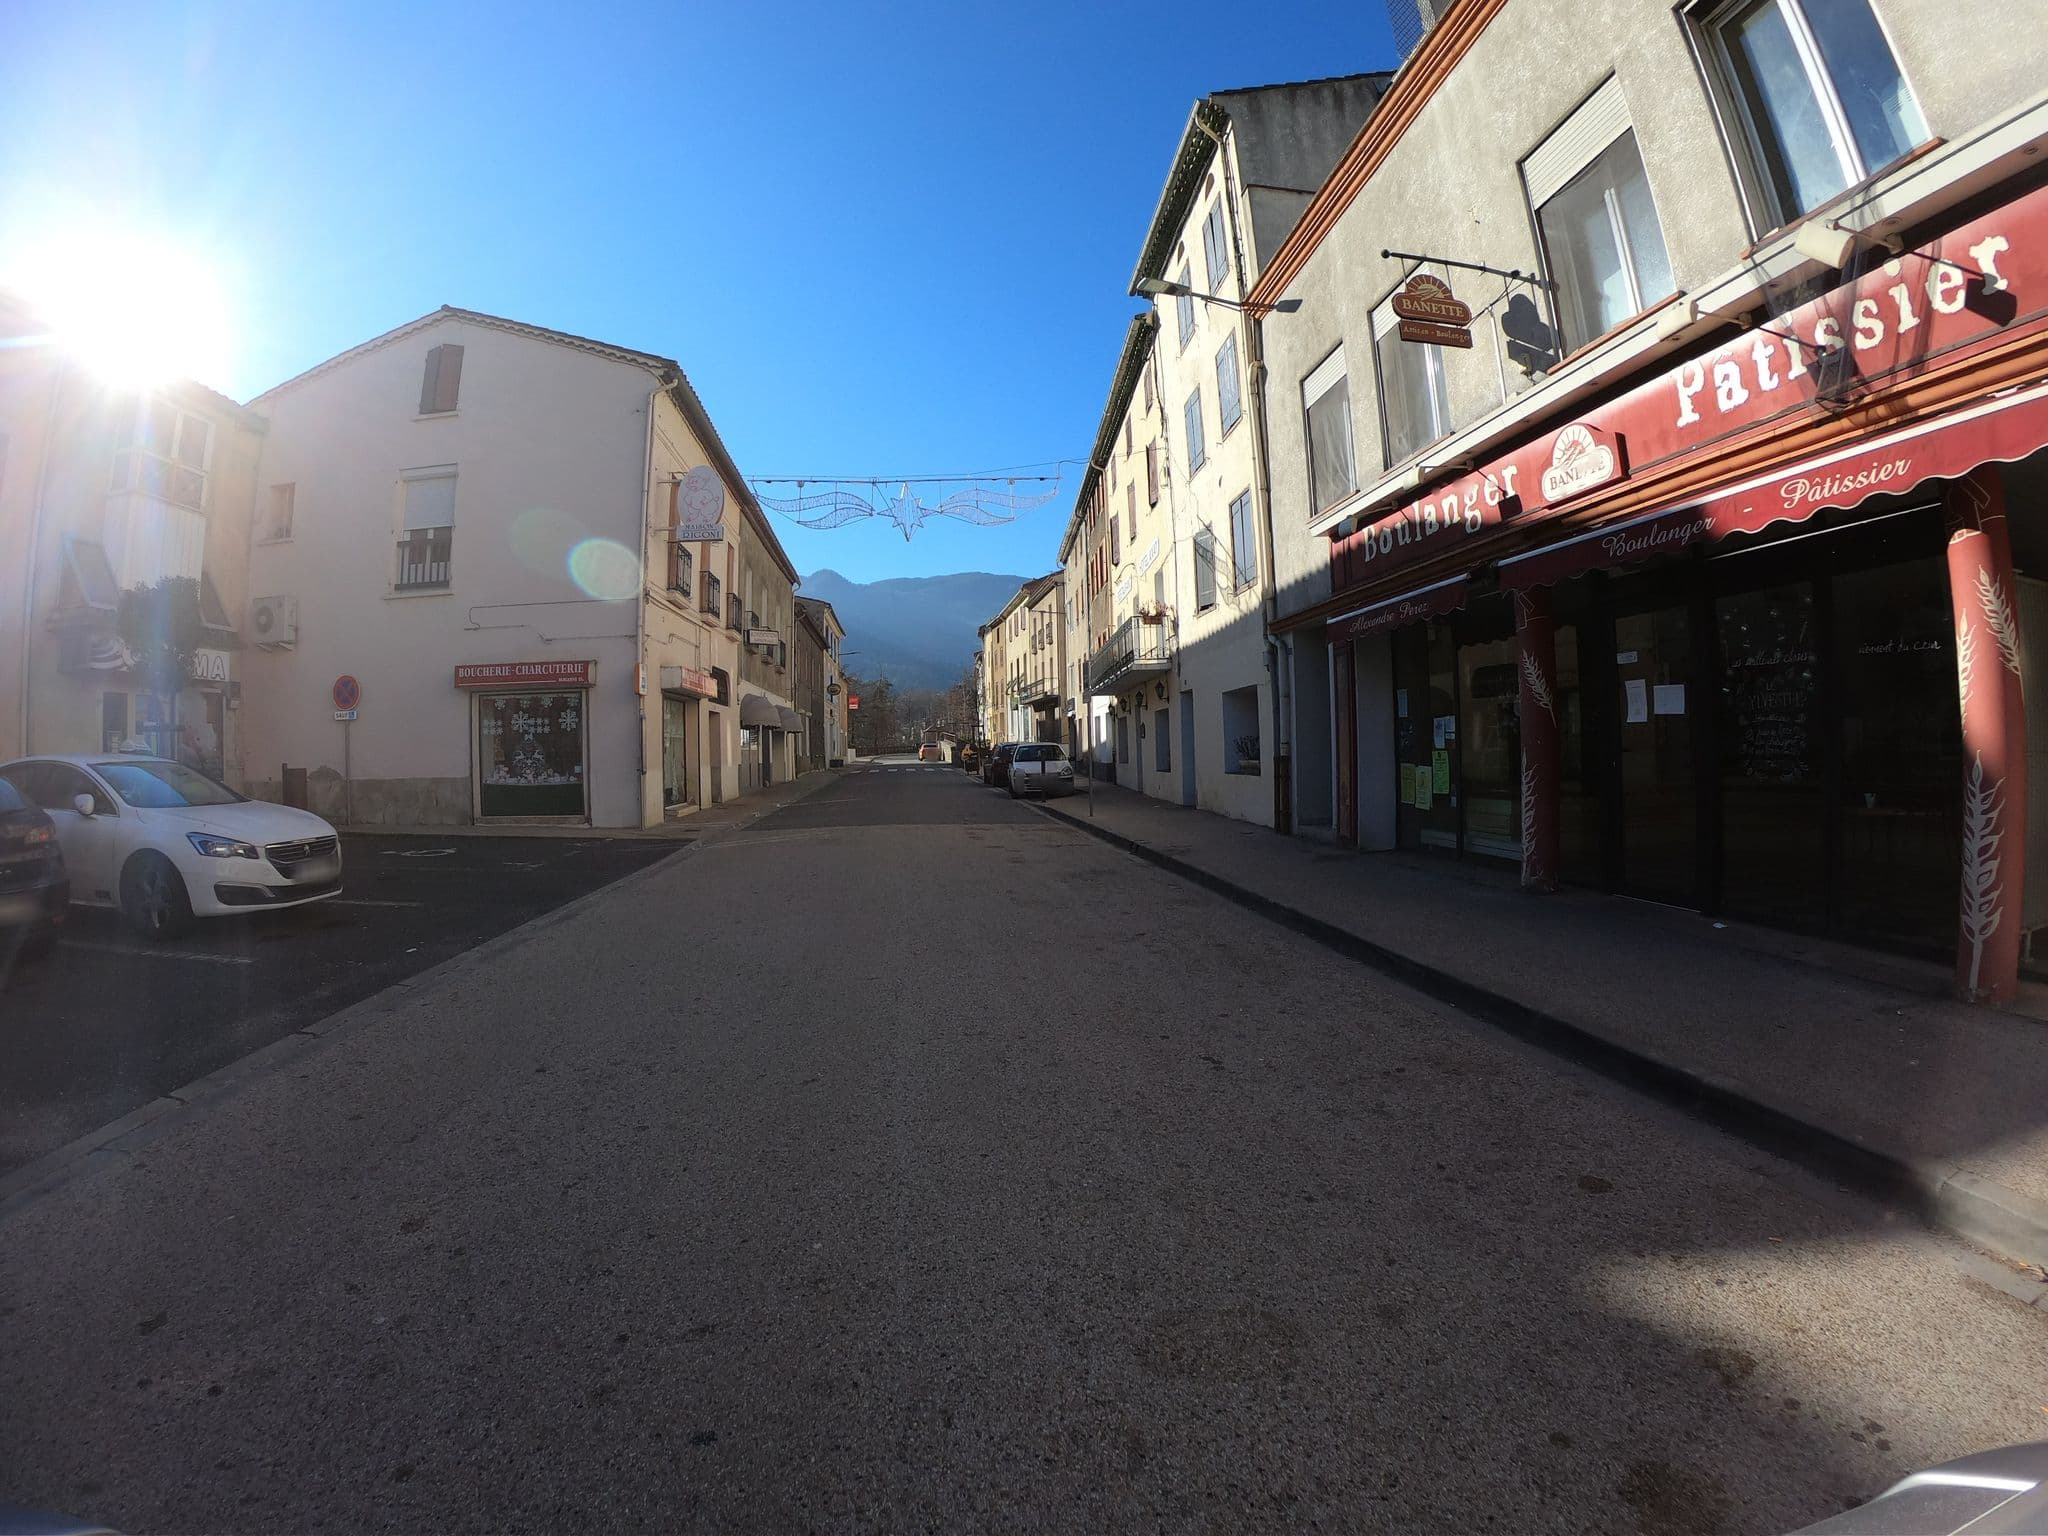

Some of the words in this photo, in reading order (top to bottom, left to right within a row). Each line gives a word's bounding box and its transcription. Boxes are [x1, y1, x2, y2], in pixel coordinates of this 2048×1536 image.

[1402, 298, 1464, 317] BANETTE
[1673, 236, 2010, 428] Pâtissier
[682, 531, 720, 539] RIGONI
[1362, 465, 1518, 562] Boulanger
[1602, 516, 1717, 559] Boulanger
[1780, 457, 1912, 509] Pâtissier
